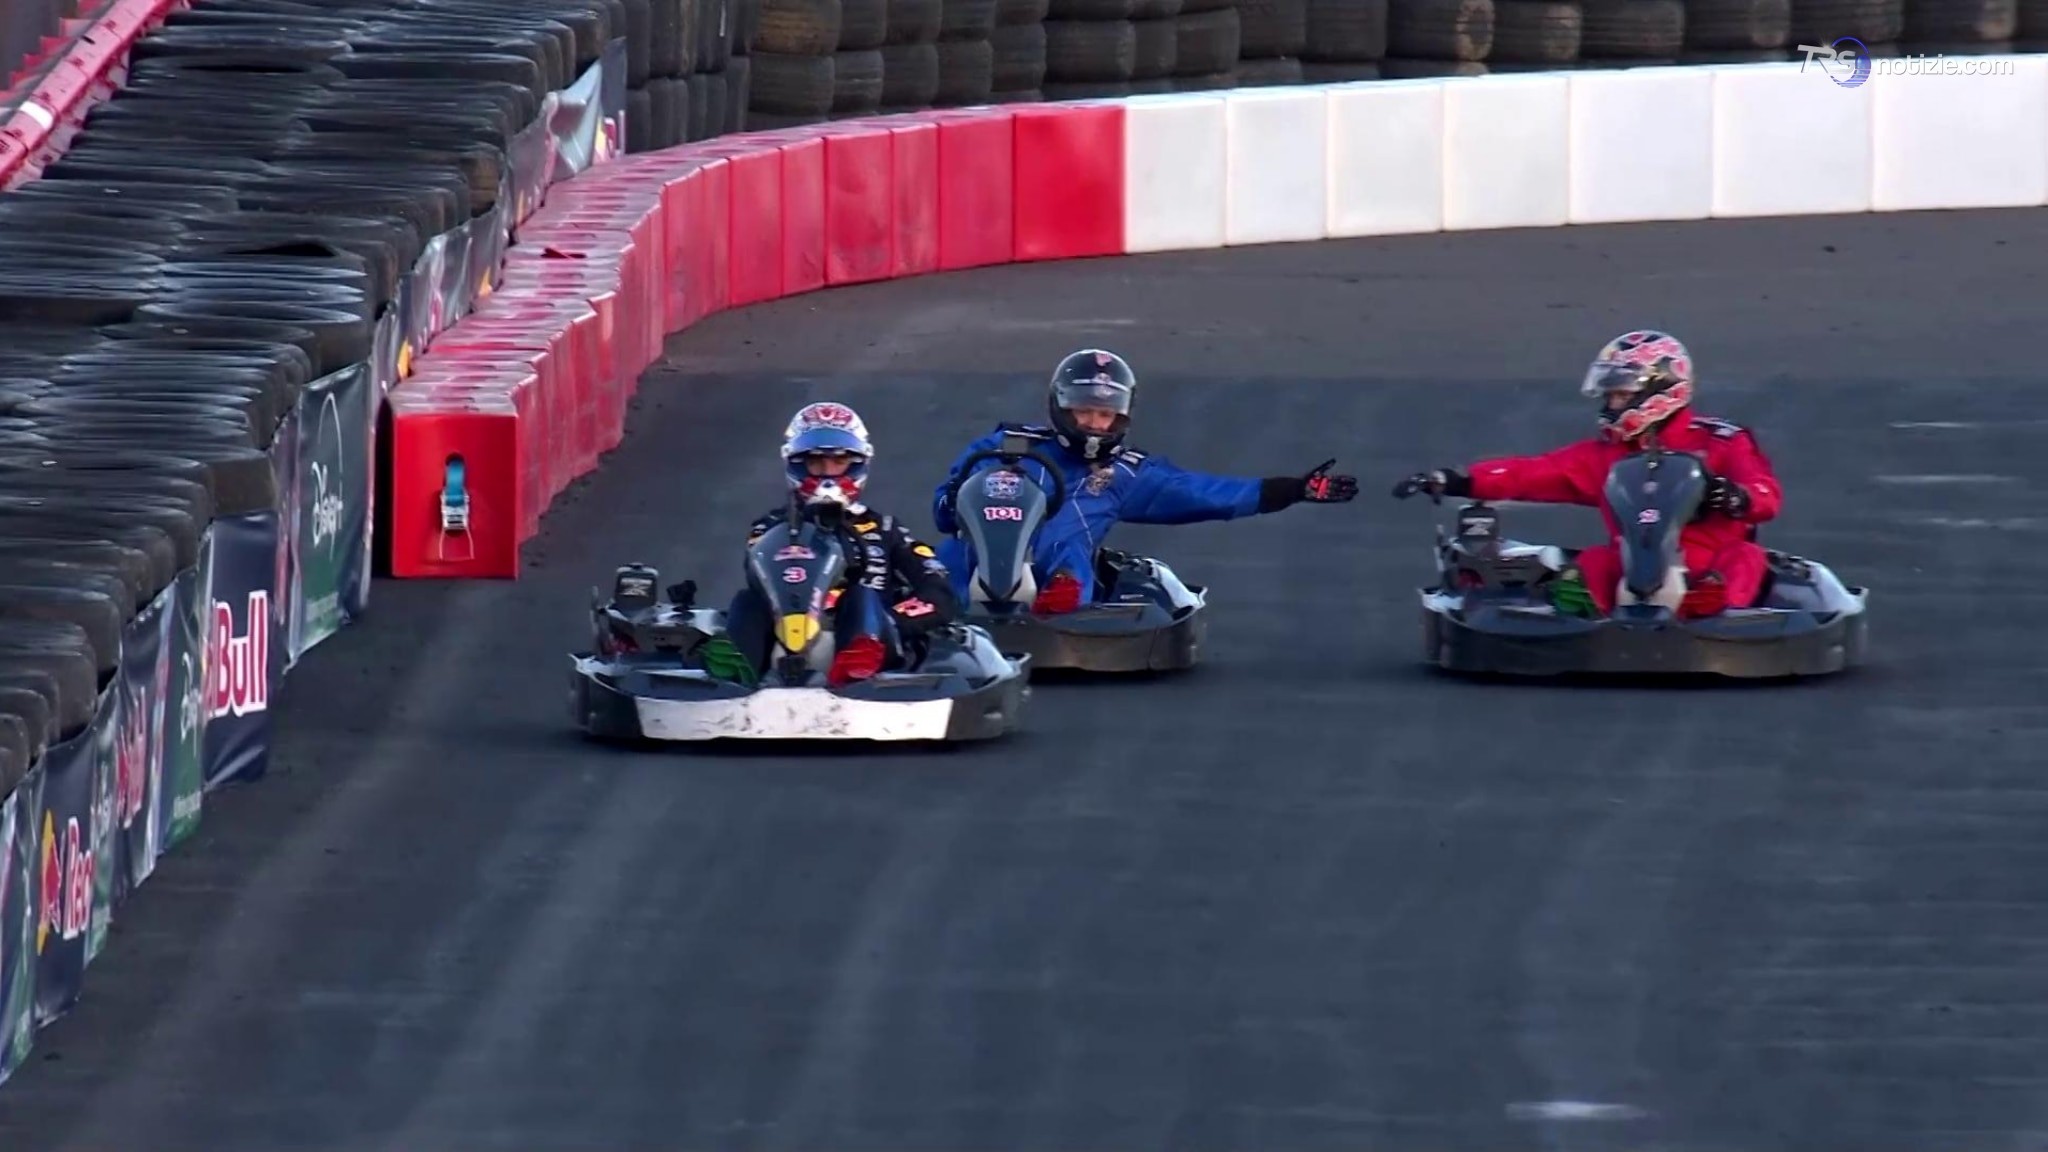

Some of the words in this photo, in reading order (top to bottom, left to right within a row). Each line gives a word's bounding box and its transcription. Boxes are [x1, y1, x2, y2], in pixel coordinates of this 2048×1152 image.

[983, 506, 1023, 521] 101
[782, 565, 807, 583] 3
[211, 589, 268, 718] Bull
